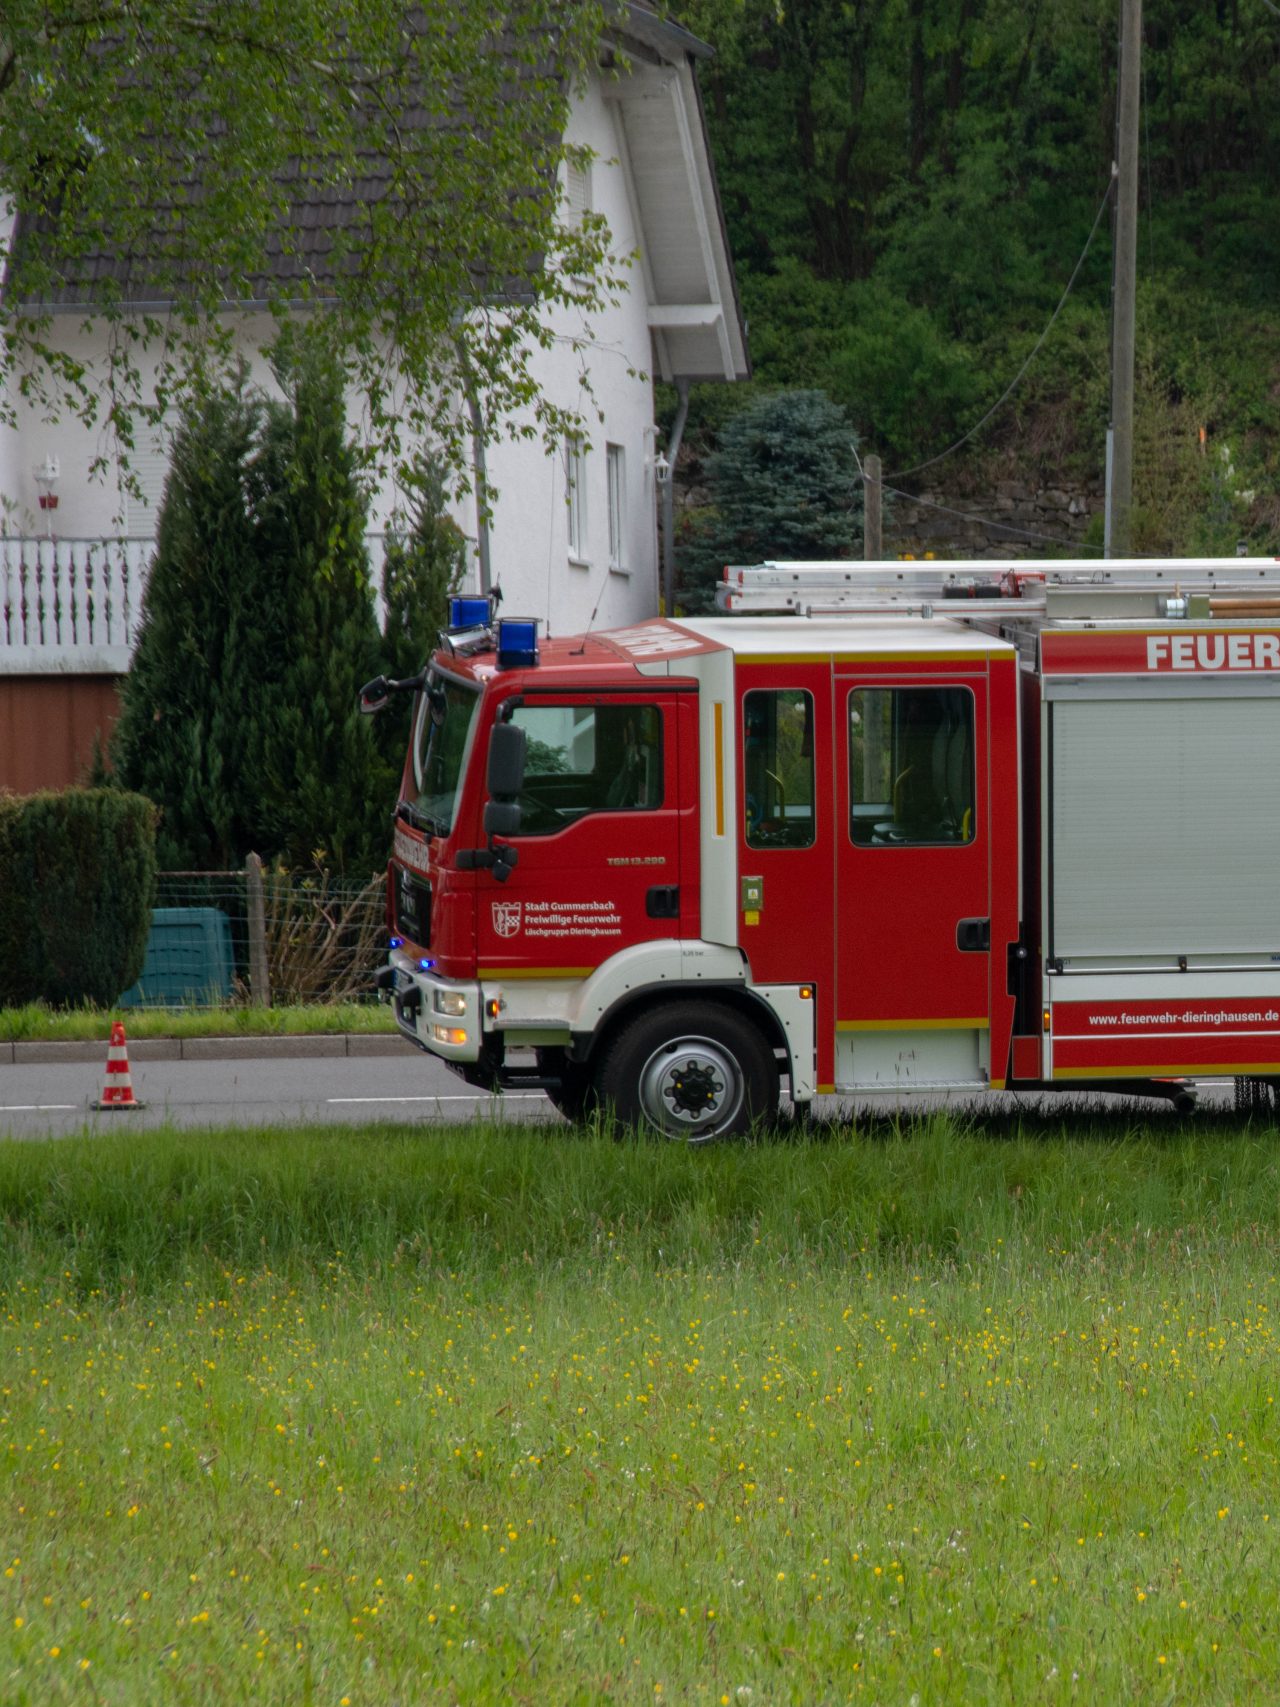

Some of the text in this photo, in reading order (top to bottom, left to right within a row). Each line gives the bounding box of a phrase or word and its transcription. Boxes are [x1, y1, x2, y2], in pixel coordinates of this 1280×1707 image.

[607, 857, 666, 866] TGM 13.290
[525, 901, 615, 911] Stadt Gummersbach
[525, 914, 621, 925] Freiwillige Feuerwehr
[525, 927, 621, 936] Löschgruppe Dieringhausen
[1089, 1010, 1280, 1025] www.feuerwehr-dieringhausen.de
